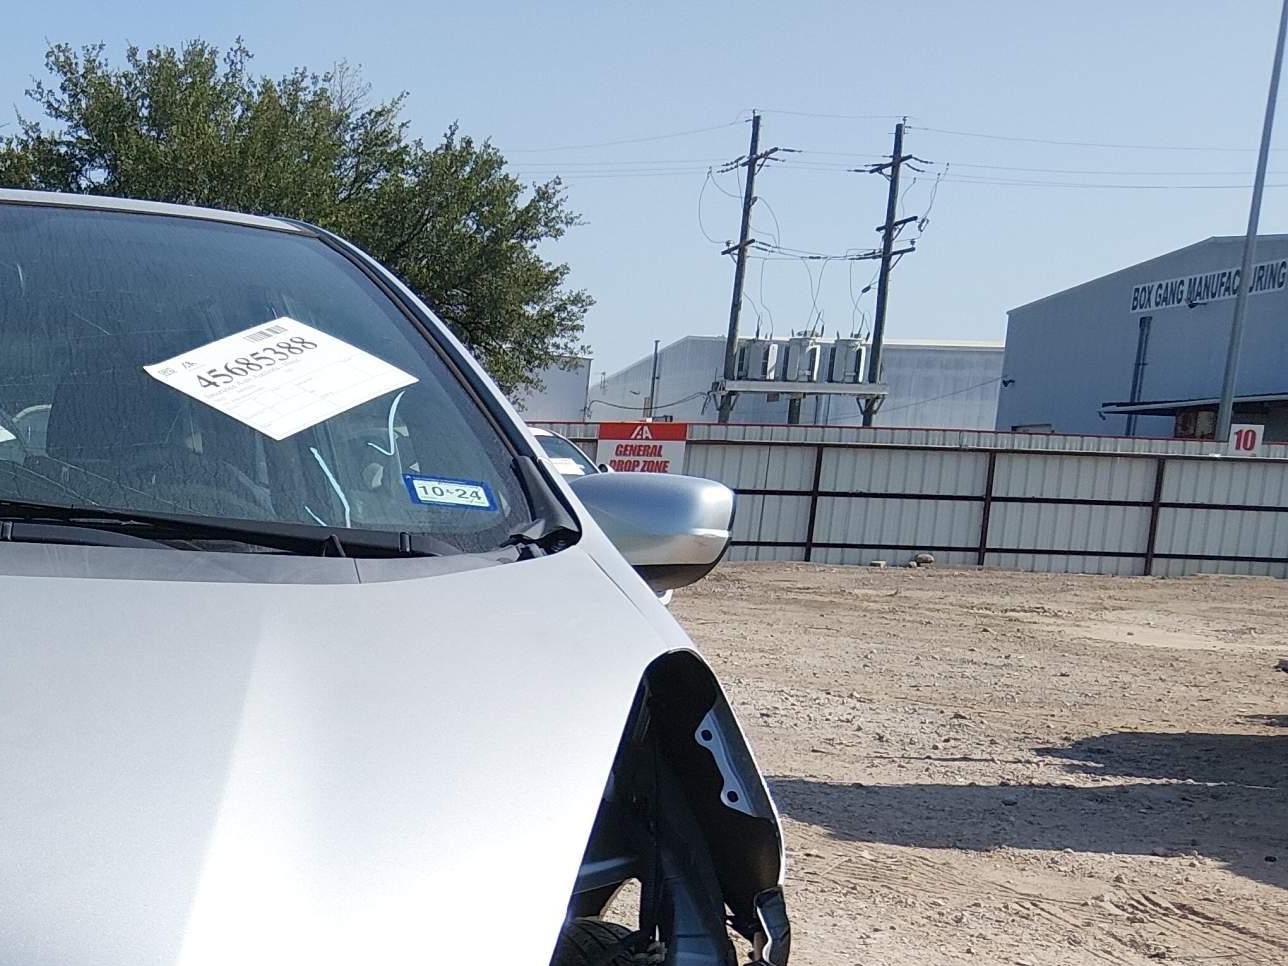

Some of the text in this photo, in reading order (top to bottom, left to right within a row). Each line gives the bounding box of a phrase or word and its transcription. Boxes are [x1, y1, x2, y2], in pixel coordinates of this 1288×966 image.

[1131, 261, 1287, 311] BOX GANG MANUFACURING
[196, 336, 318, 389] 45685388
[614, 444, 664, 458] GENERAL
[1234, 429, 1256, 451] 10
[609, 460, 670, 473] DROP ZONE
